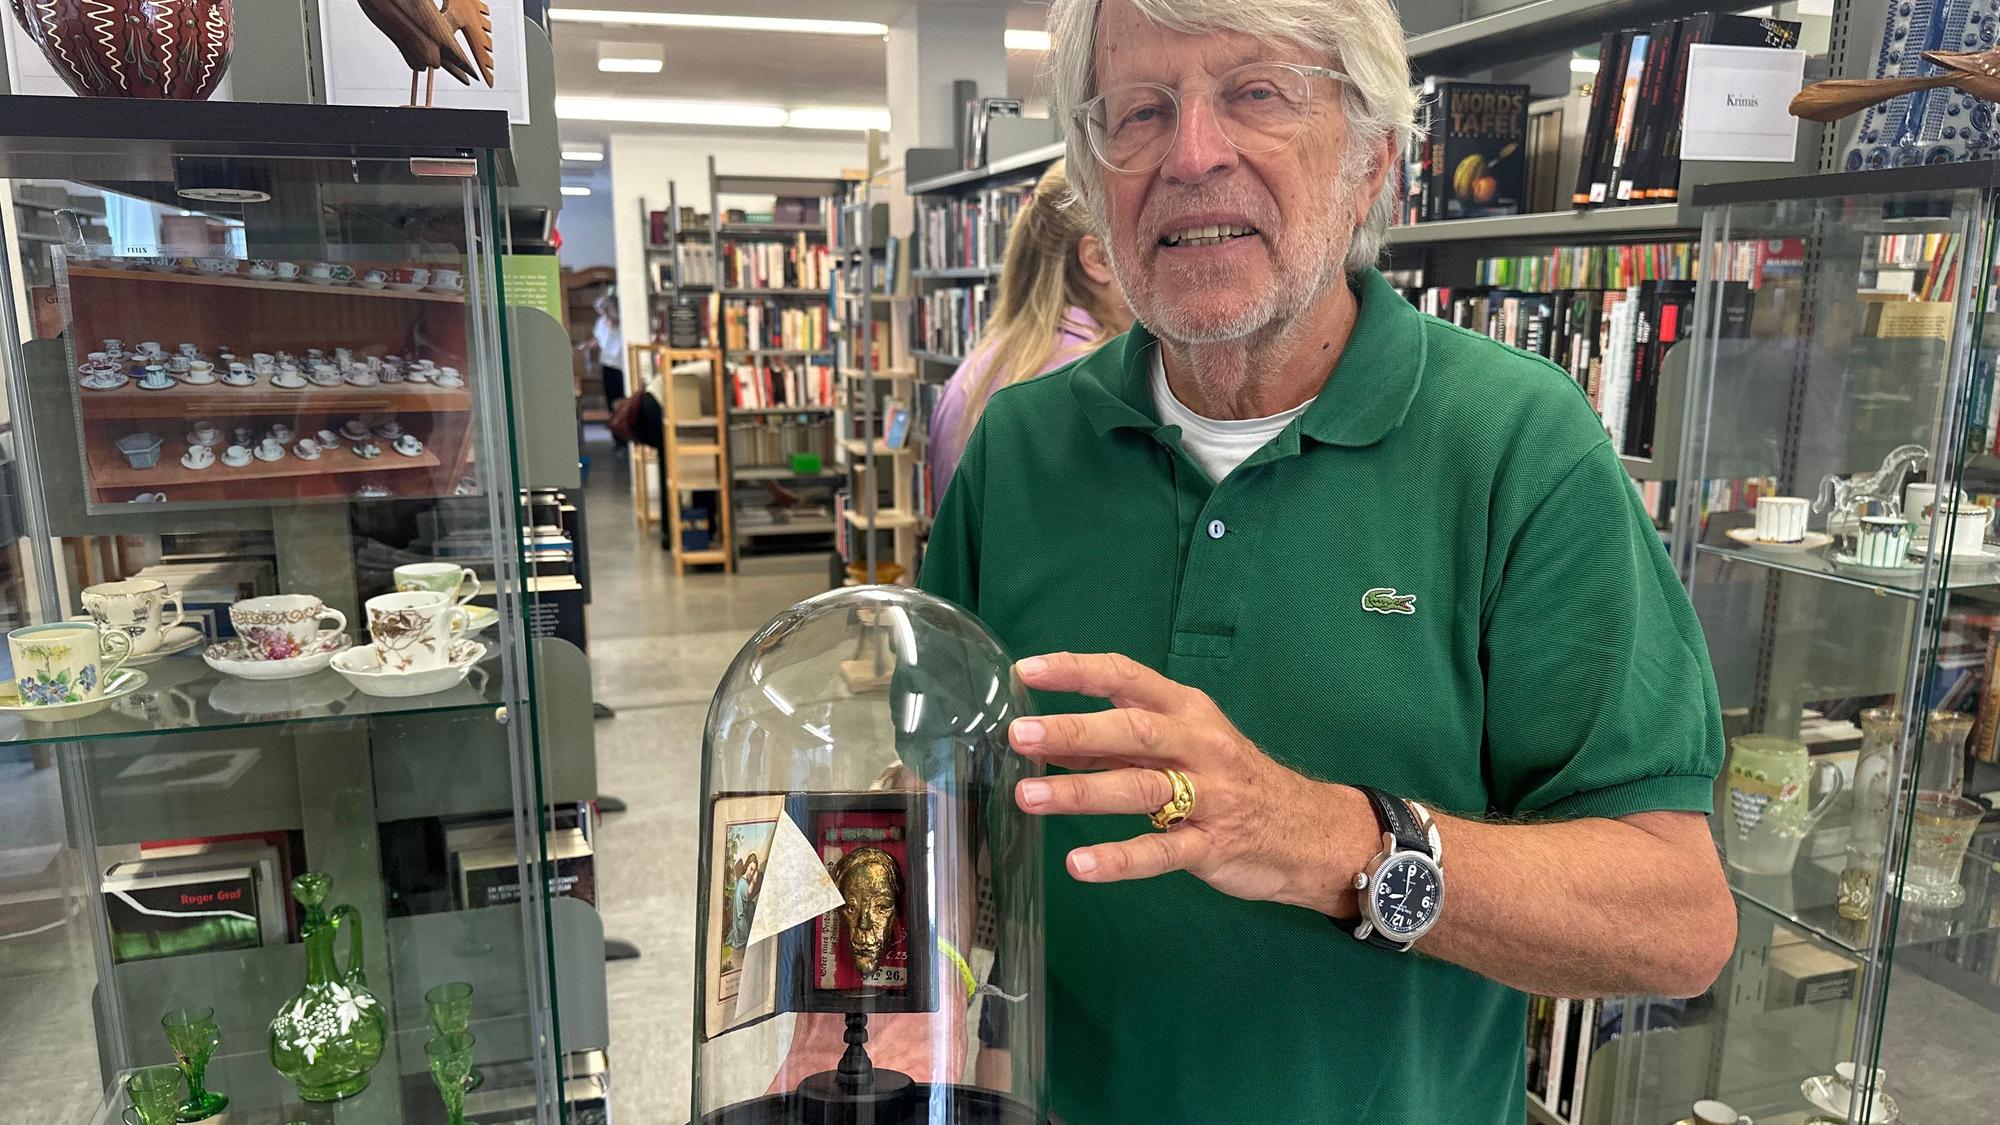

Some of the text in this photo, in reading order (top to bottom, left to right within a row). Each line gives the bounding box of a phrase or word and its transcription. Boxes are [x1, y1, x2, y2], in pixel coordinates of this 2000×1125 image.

[1451, 93, 1523, 114] MORDS
[1726, 94, 1759, 107] Krimis
[1451, 114, 1521, 135] TAFEL
[1379, 883, 1388, 895] 3
[181, 889, 241, 905] Roger Graf
[1422, 896, 1430, 908] 9
[1392, 914, 1404, 927] 12
[885, 970, 904, 981] 26.
